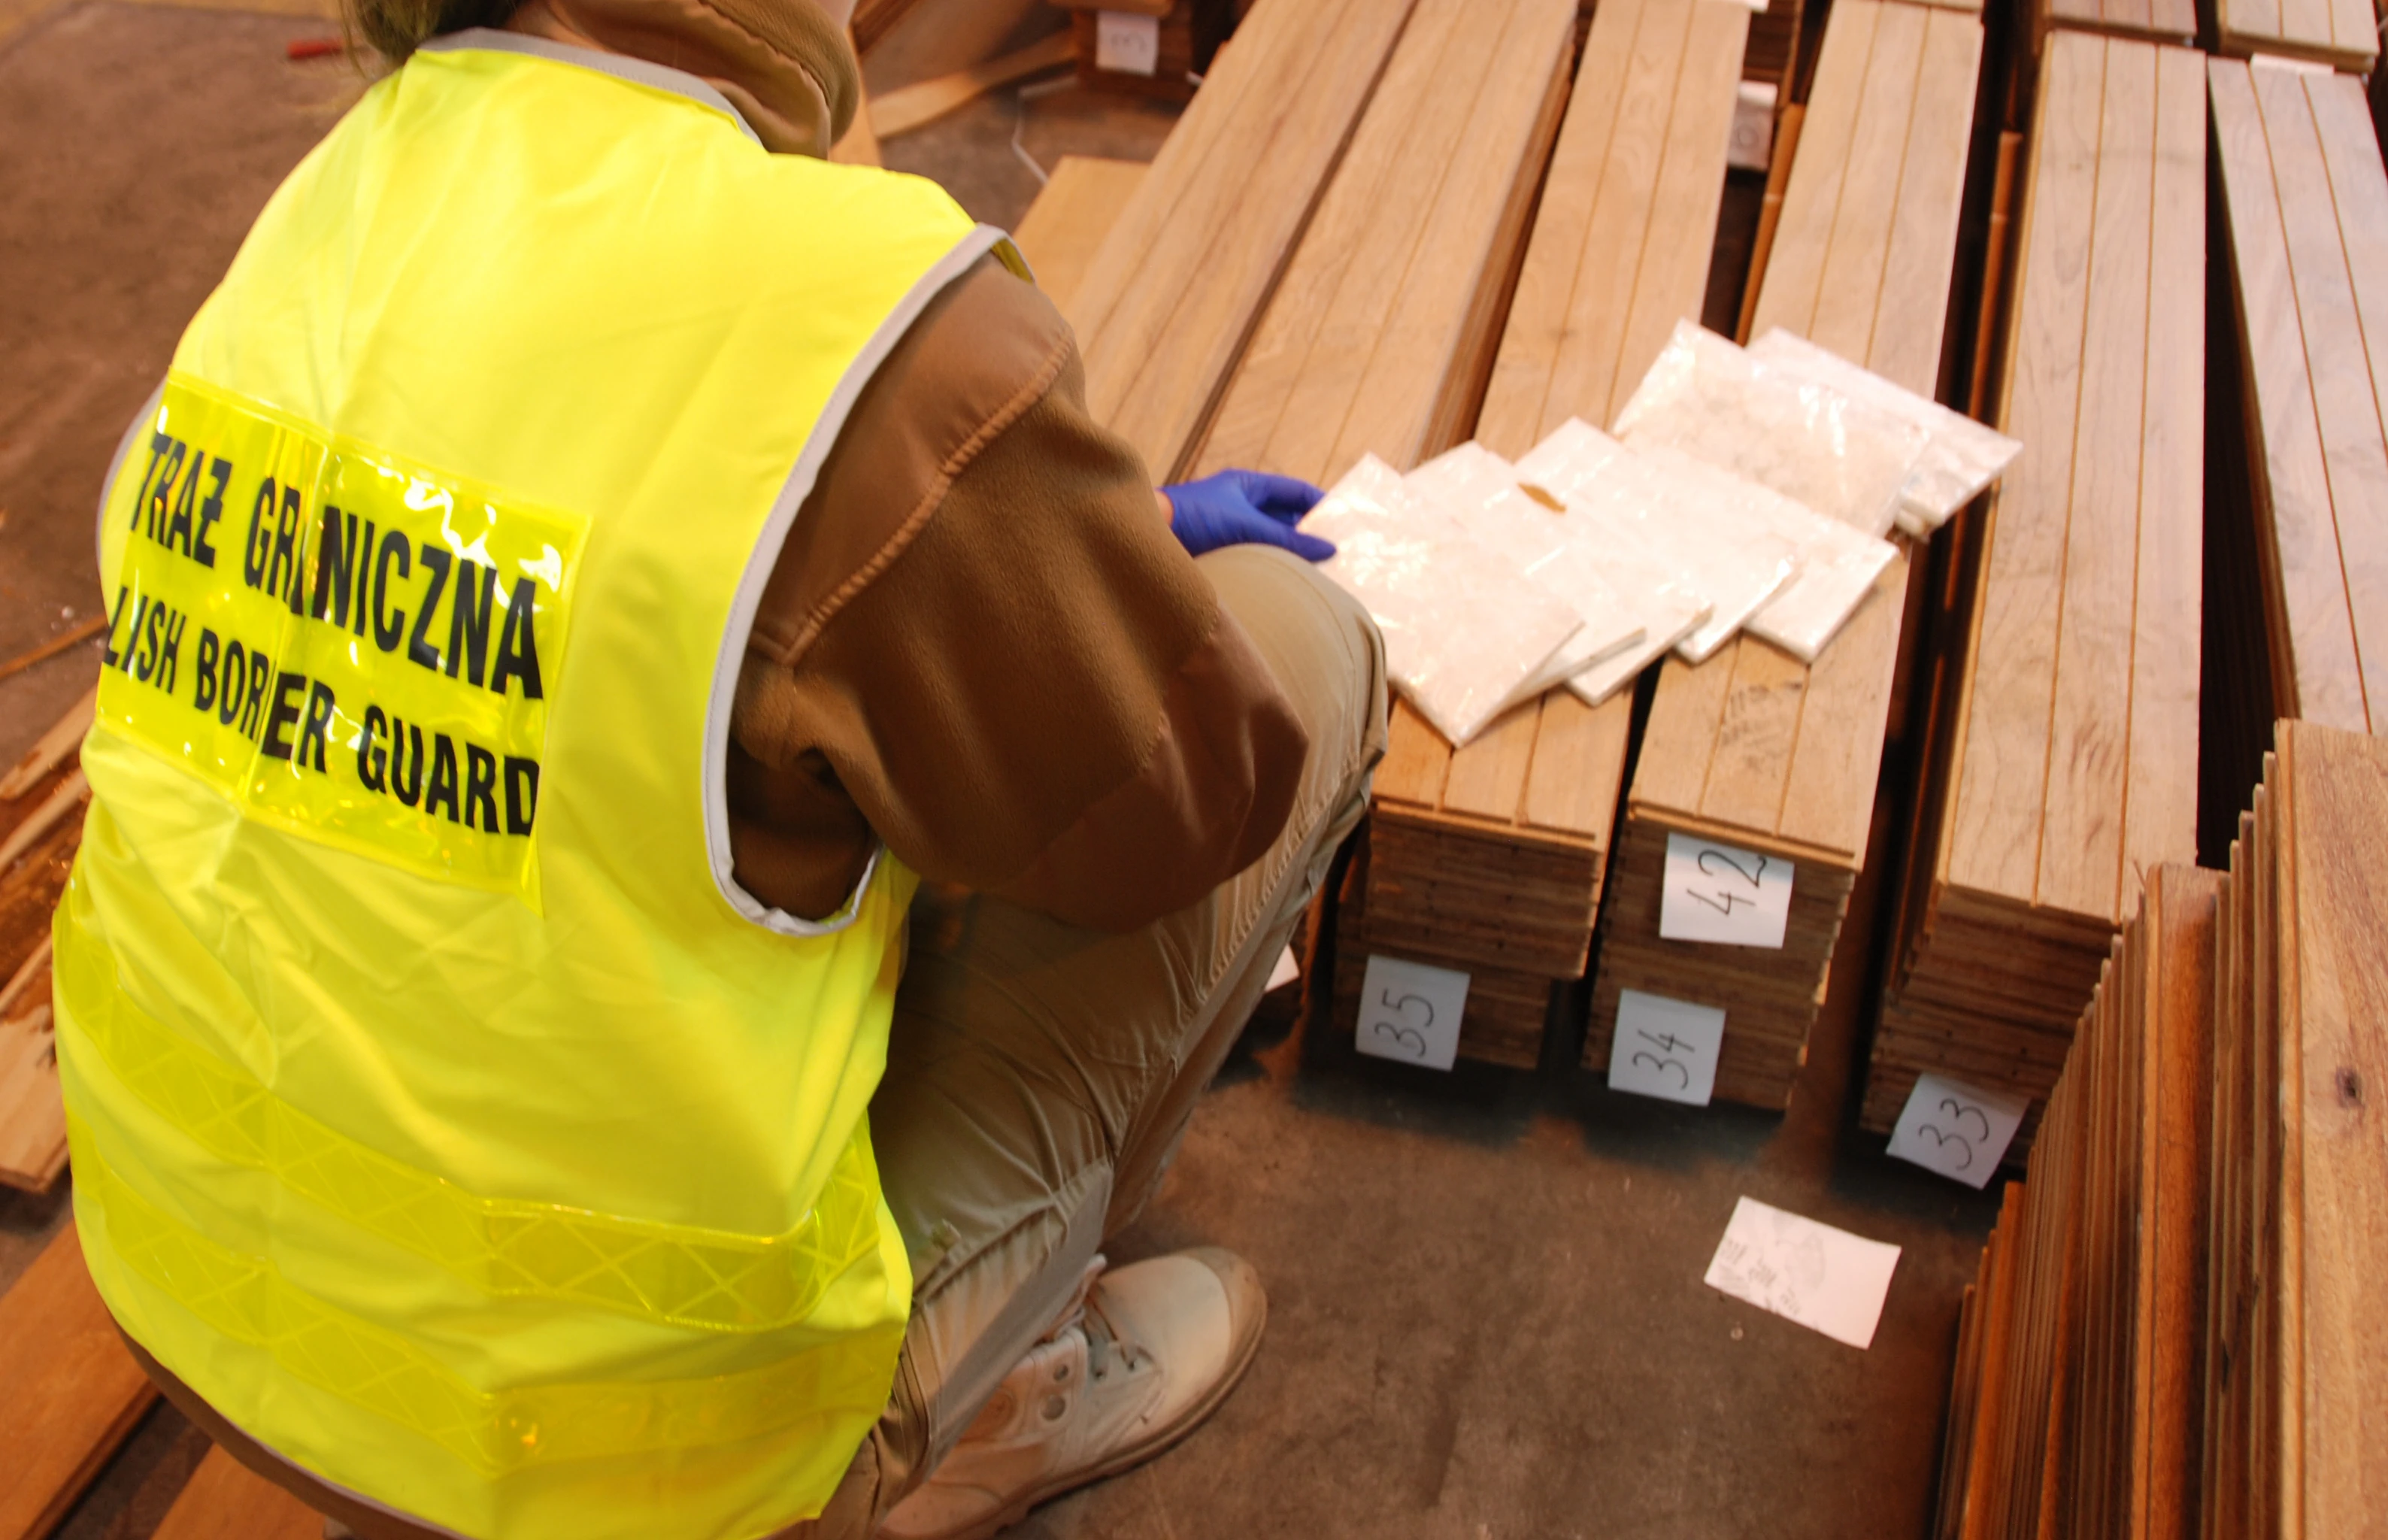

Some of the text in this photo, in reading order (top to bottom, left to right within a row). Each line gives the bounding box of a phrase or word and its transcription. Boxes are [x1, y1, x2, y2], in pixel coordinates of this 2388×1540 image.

[194, 627, 335, 774] BORER
[356, 705, 541, 838] GUARD
[1685, 848, 1769, 917] 42
[1374, 988, 1435, 1058] 35
[1631, 1028, 1696, 1091] 34
[1917, 1098, 1990, 1172] 33
